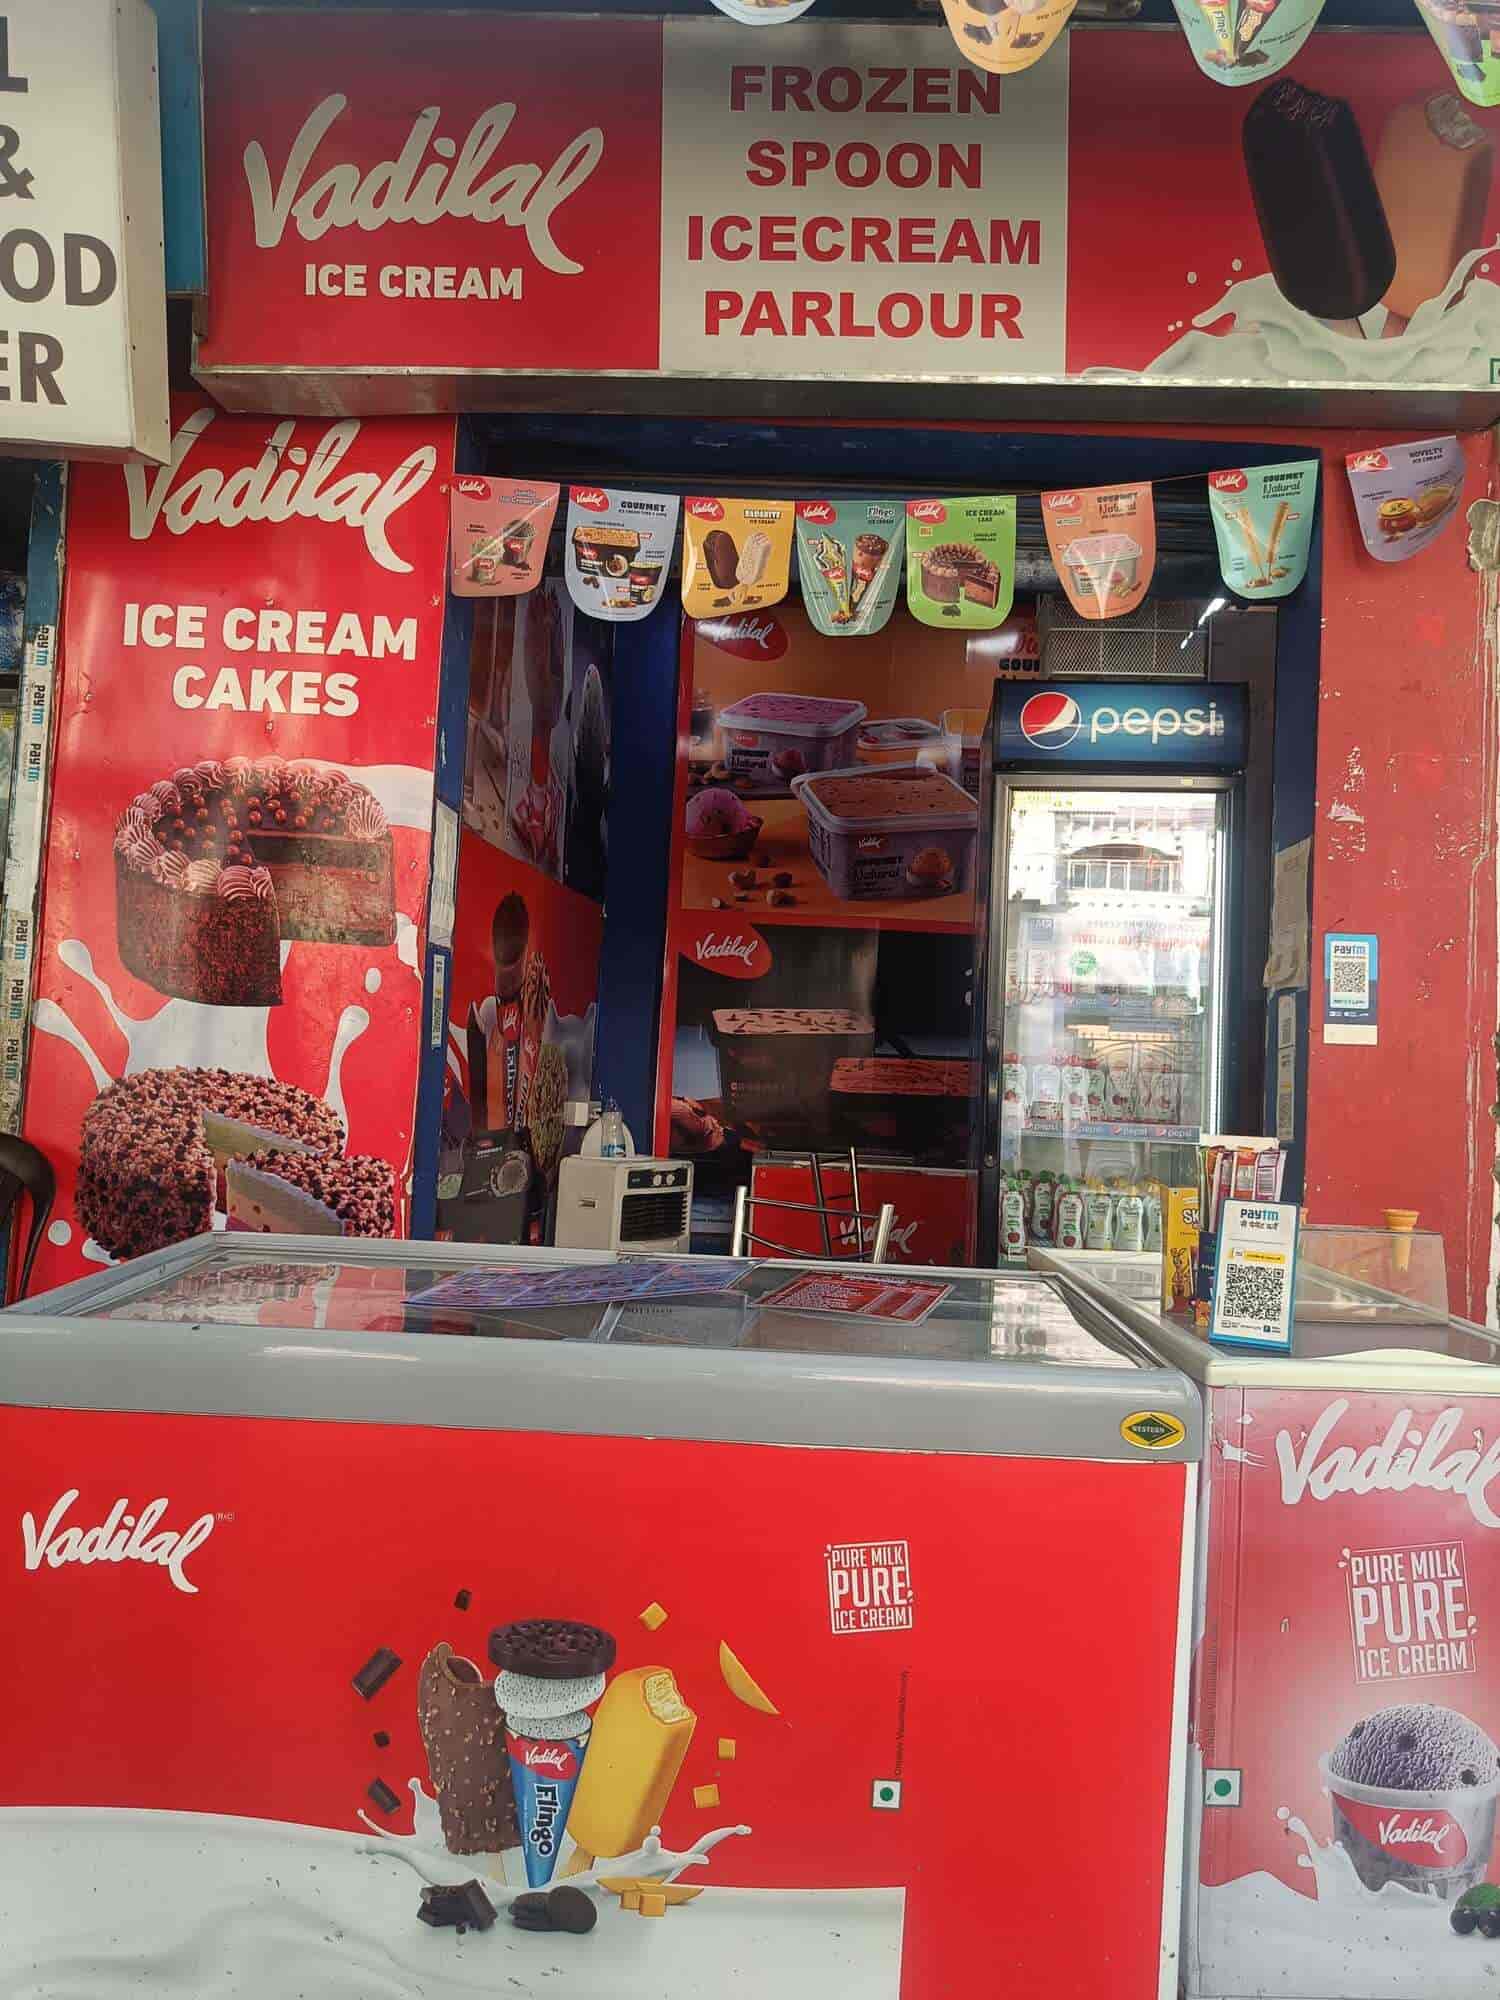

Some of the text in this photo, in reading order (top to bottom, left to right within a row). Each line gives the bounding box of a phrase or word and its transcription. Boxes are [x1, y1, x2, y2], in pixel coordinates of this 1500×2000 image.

[729, 65, 1001, 115] FROZEN
[243, 93, 603, 274] Vadilal
[745, 139, 983, 190] SPOON
[687, 216, 1041, 265] ICECREAM
[0, 228, 117, 307] OD
[305, 263, 523, 300] ICE CREAM
[704, 290, 1025, 339] PARLOUR
[0, 330, 67, 405] R
[124, 408, 437, 573] Vadilal
[621, 501, 666, 512] GOURMET
[123, 603, 418, 661] ICE CREAM
[172, 665, 360, 717] CAKES
[1089, 702, 1217, 744] pepsi
[696, 932, 759, 966] Vadilal
[22, 1488, 215, 1593] Vadilal
[831, 1546, 904, 1568] PURE MILK
[832, 1566, 907, 1609] PURE
[1350, 1548, 1460, 1585] PURE MILK
[835, 1606, 907, 1629] ICE CREAM
[1352, 1578, 1467, 1647] PURE
[1359, 1641, 1468, 1679] ICE CREAM
[524, 1746, 568, 1771] Vadilal
[529, 1783, 561, 1857] Flingo
[1378, 1813, 1451, 1853] Vadilal
